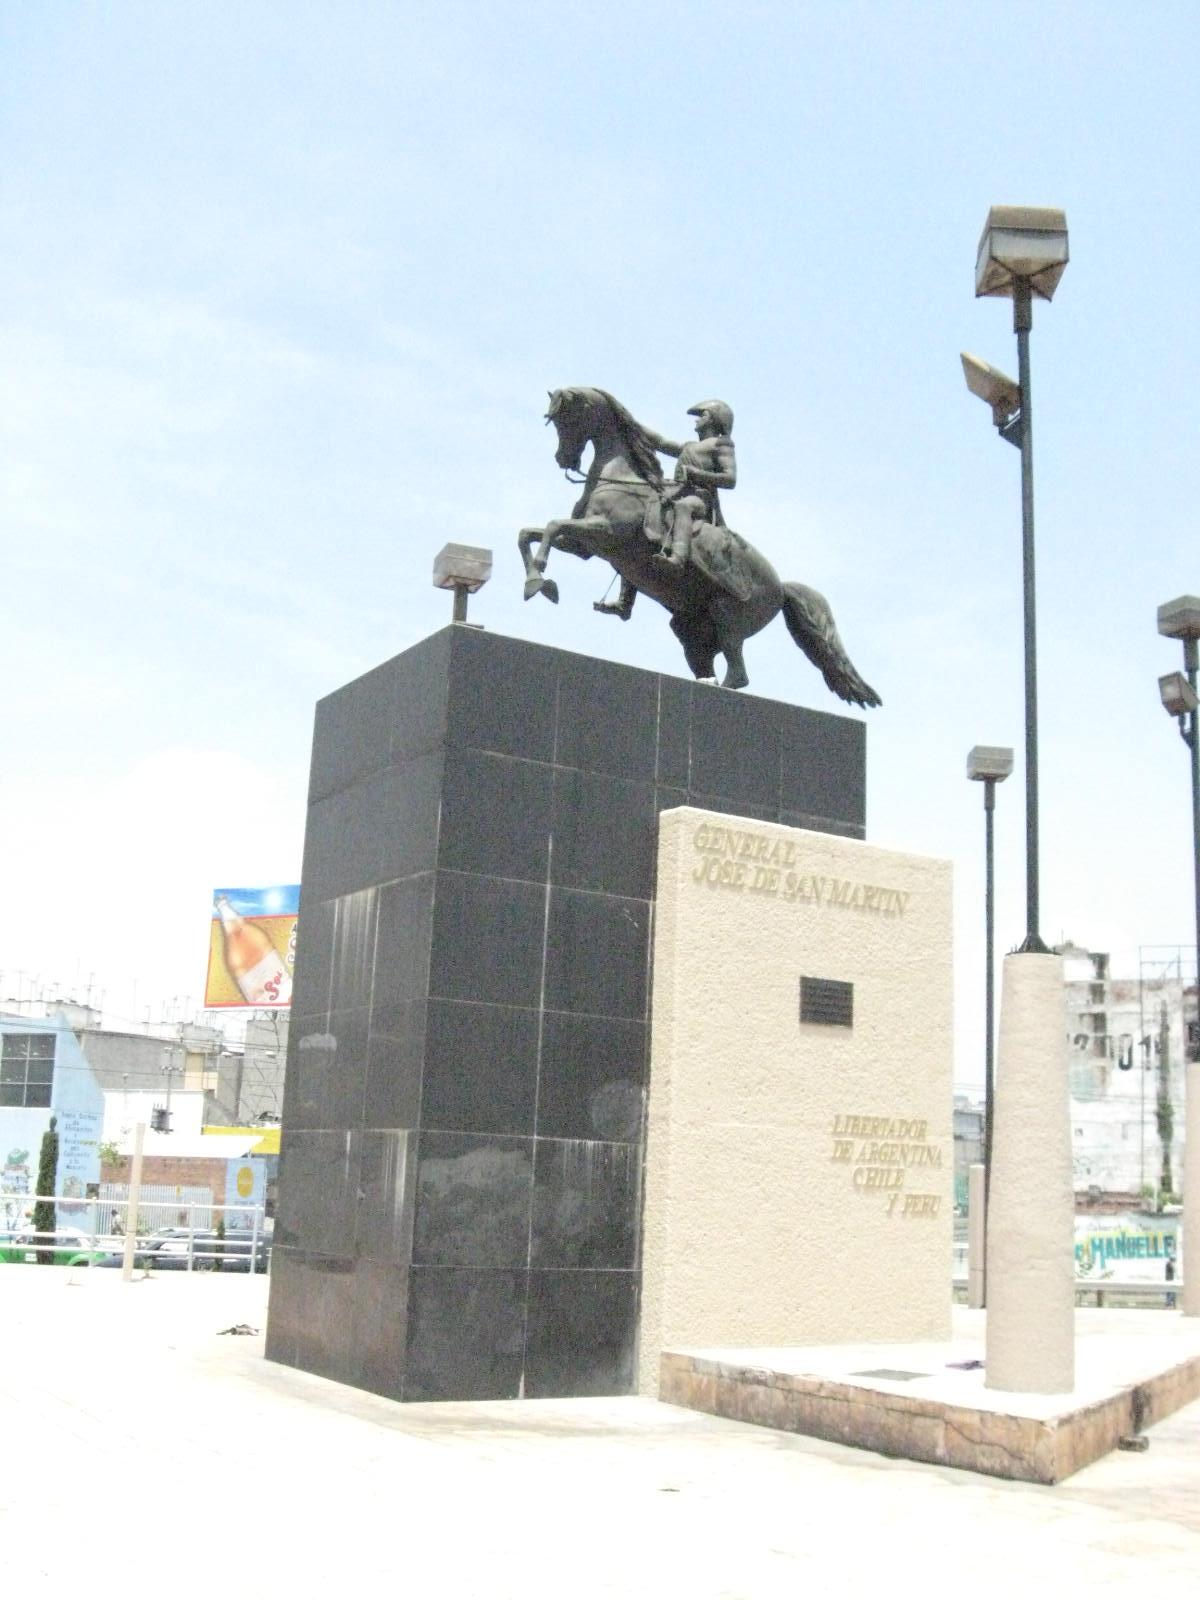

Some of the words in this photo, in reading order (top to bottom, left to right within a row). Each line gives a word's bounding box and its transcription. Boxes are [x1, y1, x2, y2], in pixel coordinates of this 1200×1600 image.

[693, 823, 798, 866] GENERAL
[692, 855, 745, 887] JOSE
[750, 865, 779, 894] DE
[783, 872, 827, 901] SAN
[828, 878, 911, 916] MARTIN
[833, 1115, 929, 1138] LIBERTADOR
[832, 1139, 854, 1158] DE
[854, 1141, 944, 1167] ARGENTINA
[852, 1167, 906, 1189] CHILE
[885, 1192, 898, 1217] Y
[901, 1194, 944, 1217] PERU
